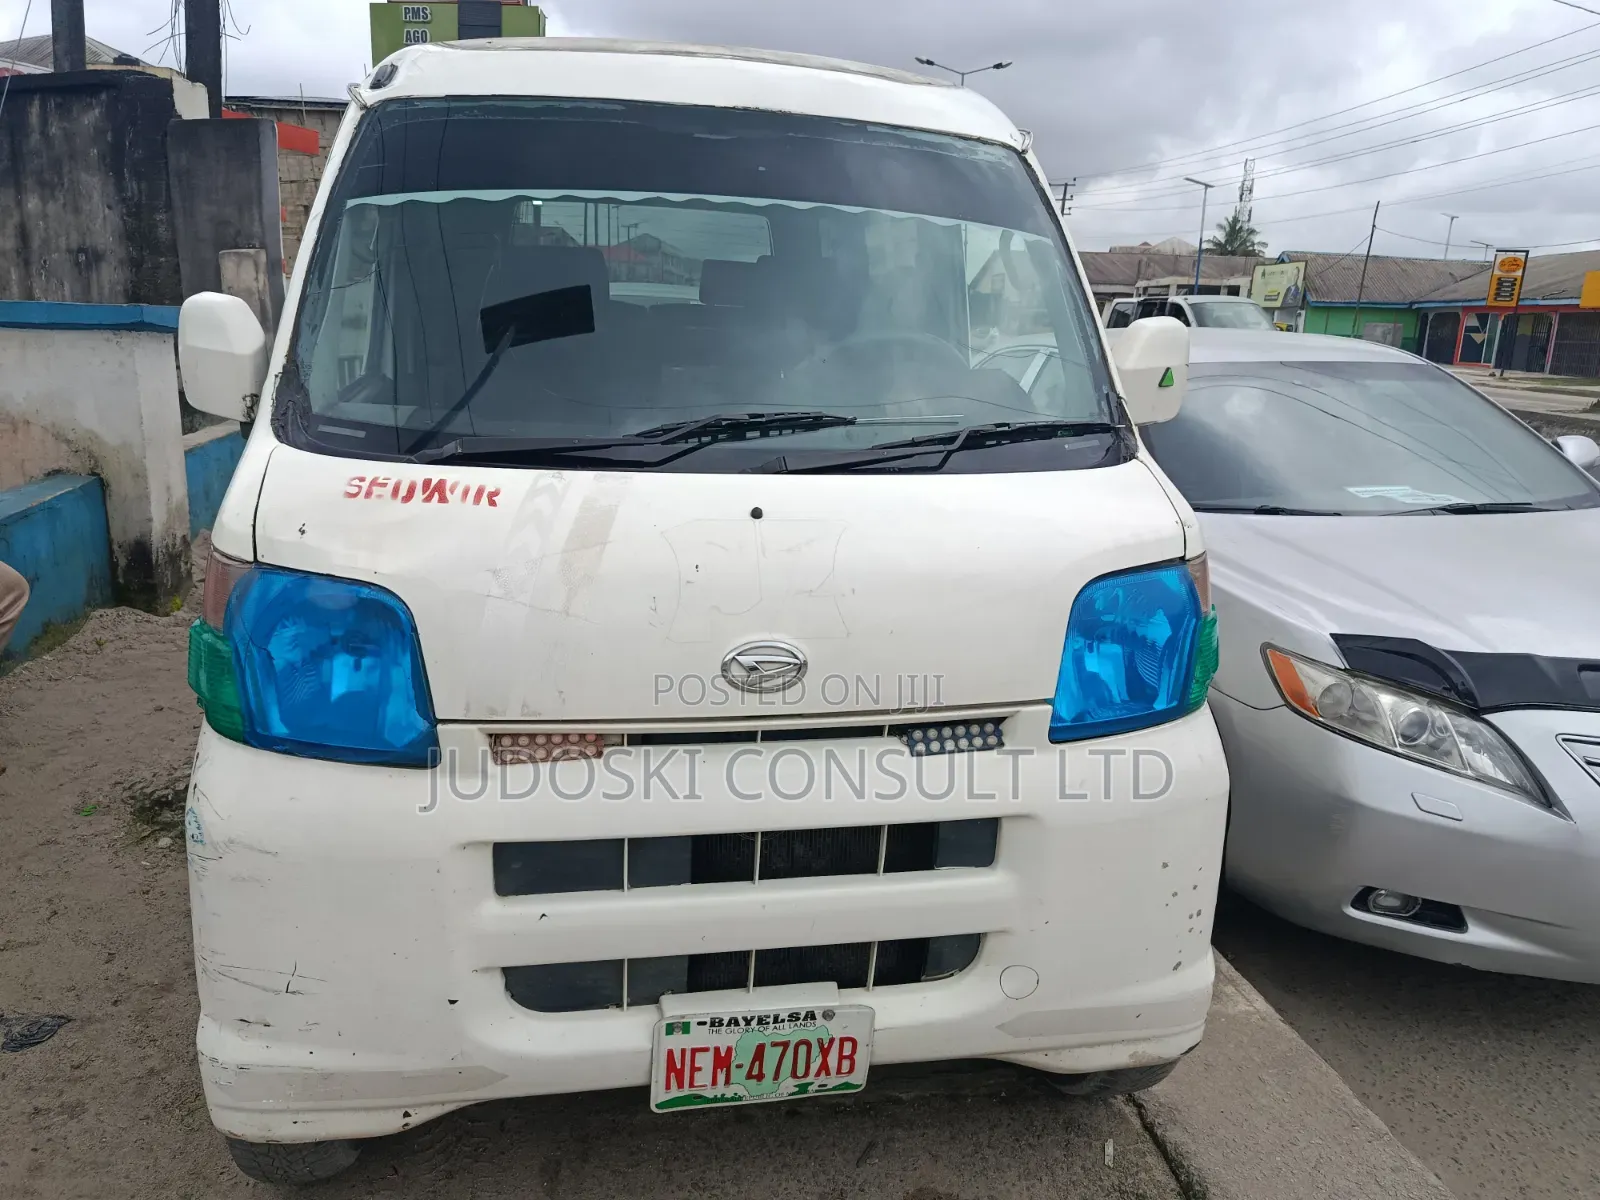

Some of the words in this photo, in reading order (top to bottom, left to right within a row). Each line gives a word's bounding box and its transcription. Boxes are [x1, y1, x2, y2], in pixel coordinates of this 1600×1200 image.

[403, 6, 430, 21] PMS
[404, 29, 429, 44] AGO
[709, 1010, 817, 1028] BAYELSA
[725, 1026, 756, 1035] GLORY
[758, 1025, 770, 1033] OF
[789, 1021, 817, 1030] LANDS
[665, 1036, 858, 1093] NEM-470XB
